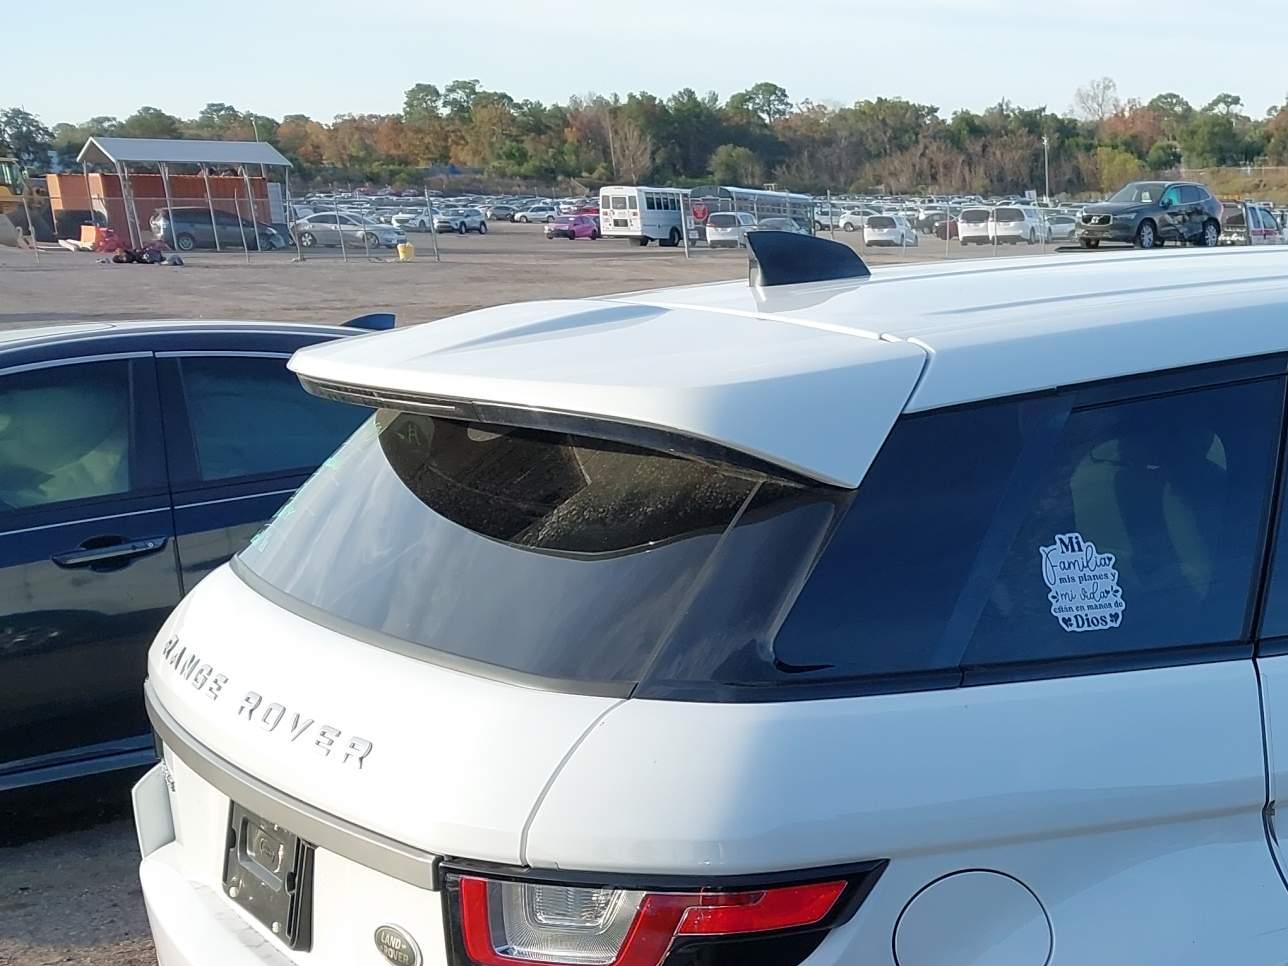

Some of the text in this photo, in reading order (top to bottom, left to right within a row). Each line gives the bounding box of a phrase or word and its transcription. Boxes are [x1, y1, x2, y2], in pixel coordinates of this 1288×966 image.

[1058, 536, 1083, 554] Mi
[1041, 545, 1112, 586] Familia
[1059, 571, 1117, 584] mis planes y
[1061, 581, 1110, 602] mi vida
[1075, 605, 1086, 613] en
[1087, 602, 1112, 611] manos
[1113, 600, 1123, 609] de
[1074, 613, 1108, 629] Dios
[162, 635, 374, 769] RANGE ROVER
